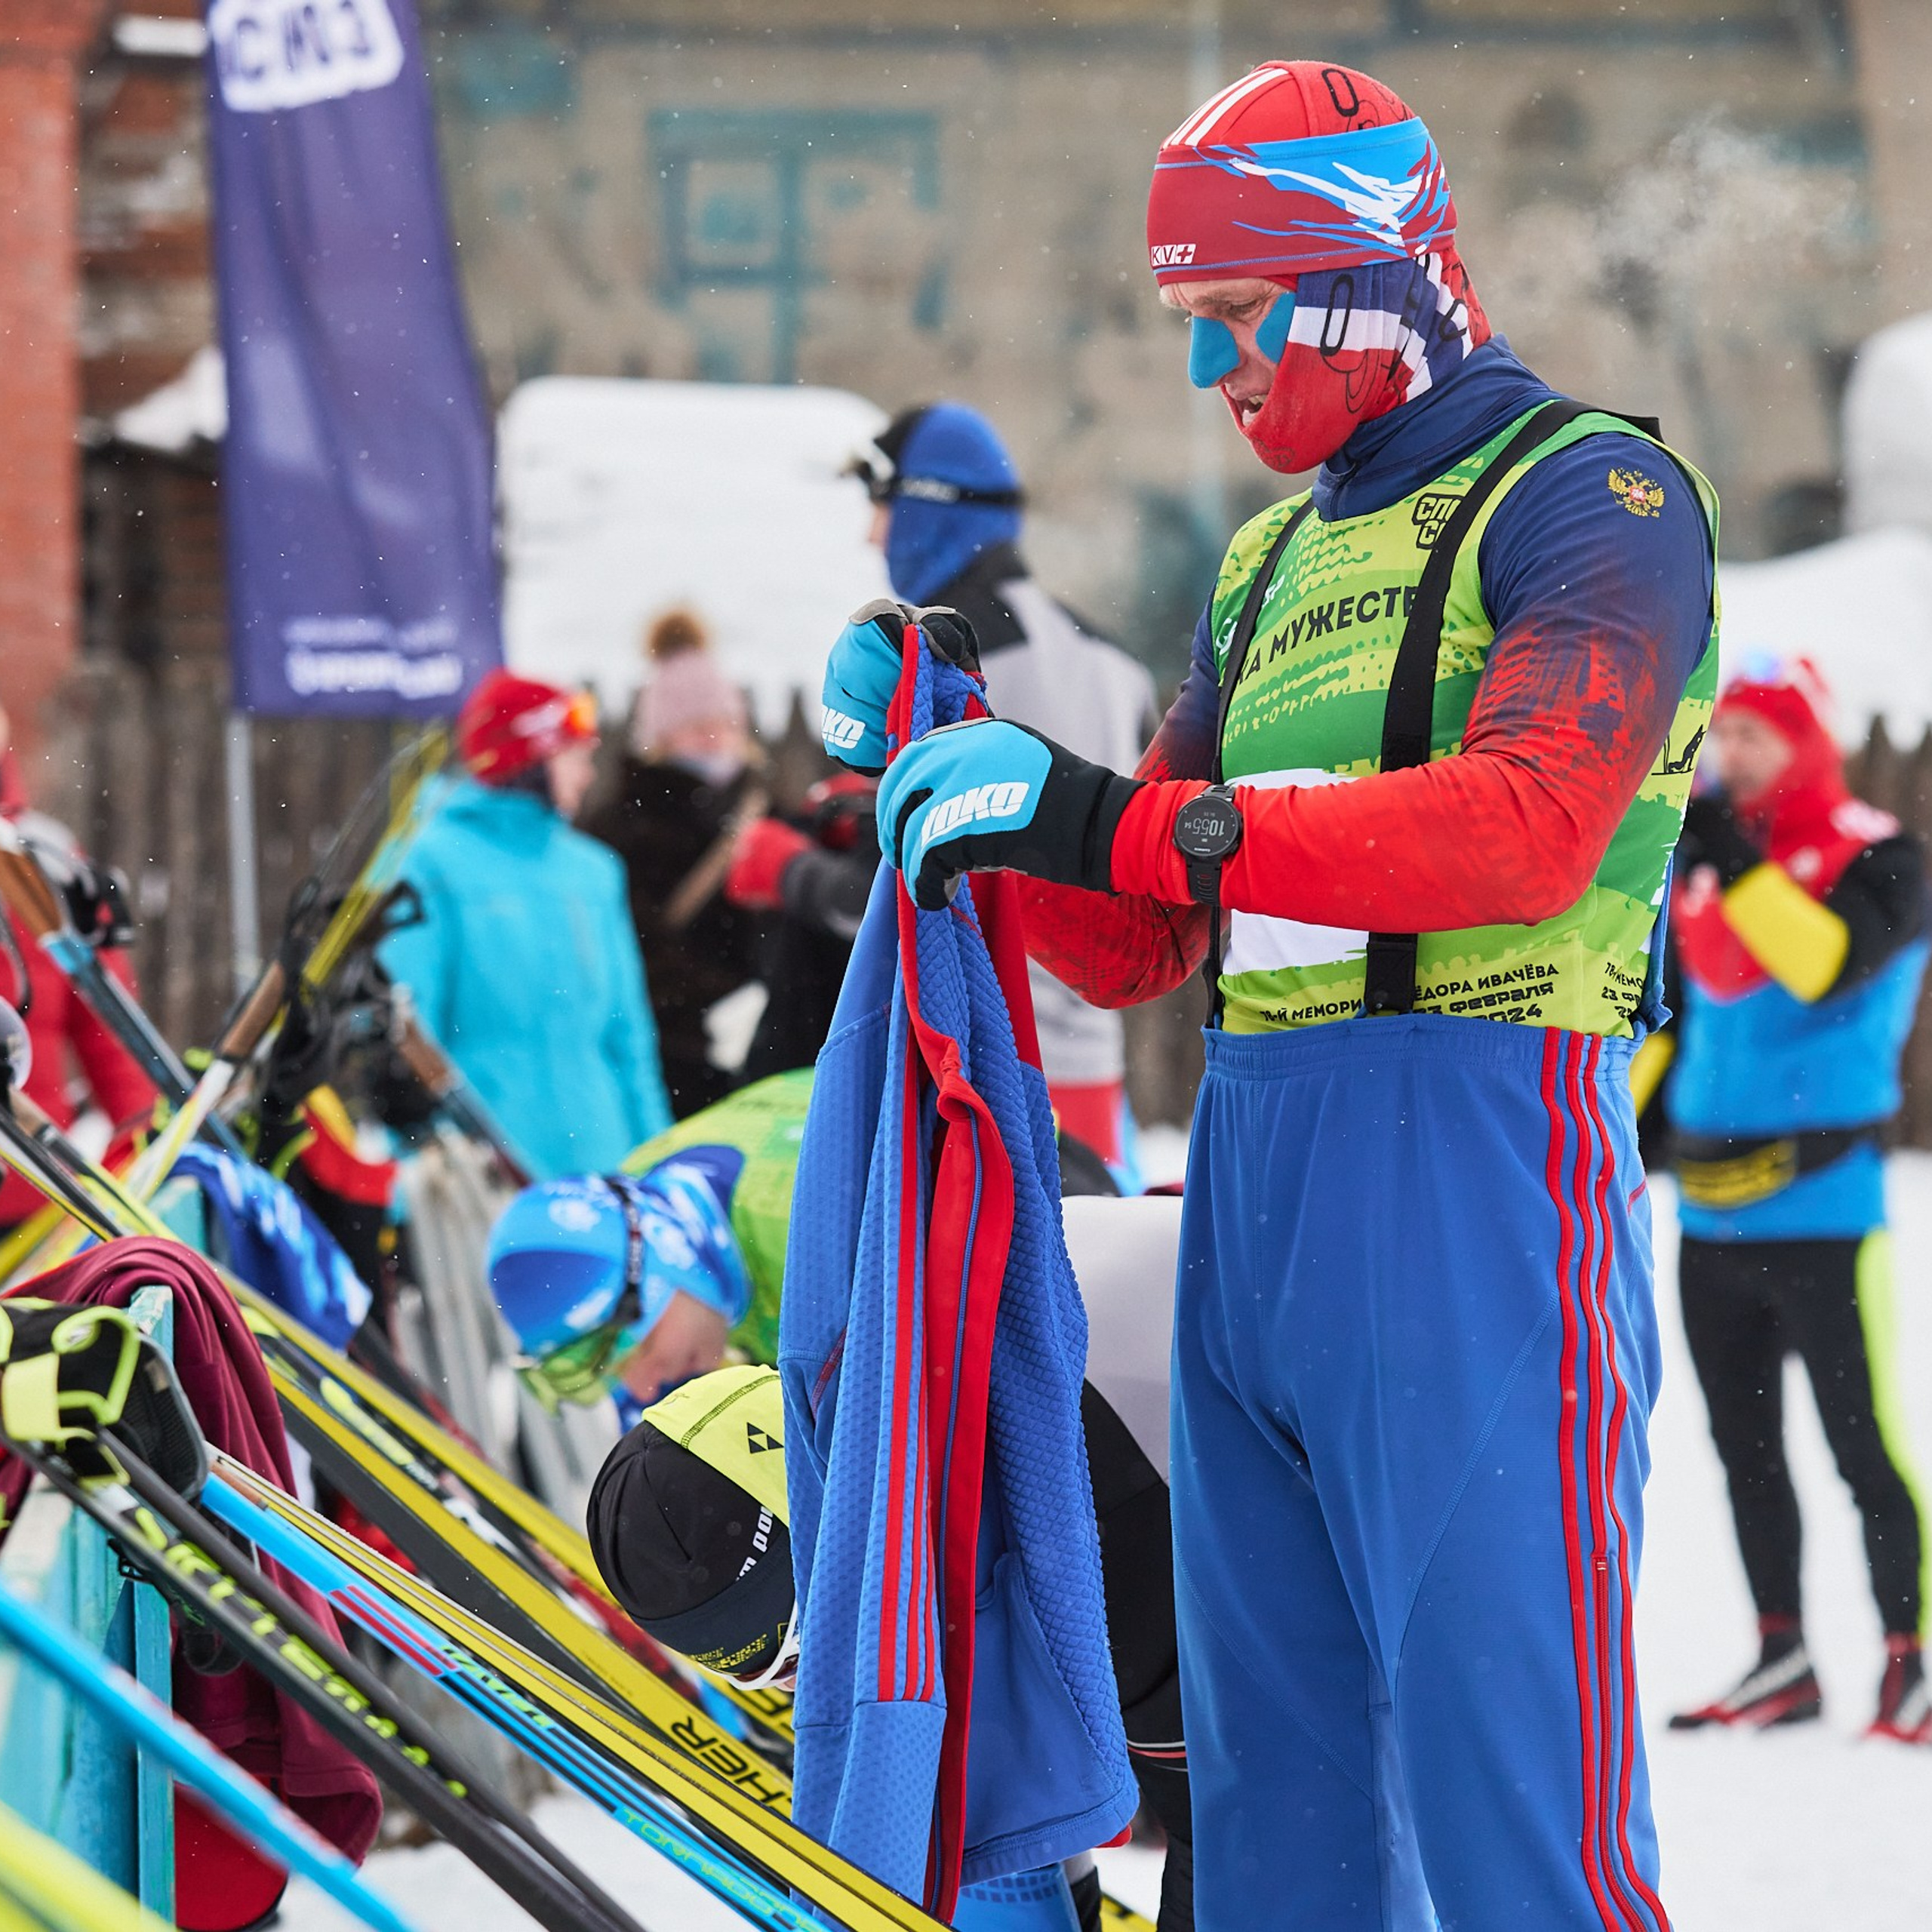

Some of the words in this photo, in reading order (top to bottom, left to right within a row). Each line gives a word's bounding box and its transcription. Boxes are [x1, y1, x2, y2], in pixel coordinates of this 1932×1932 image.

[1291, 998, 1361, 1020] МЕМОРИ
[1478, 963, 1559, 990] ИВАЧЁВА
[671, 1715, 793, 1803] HER
